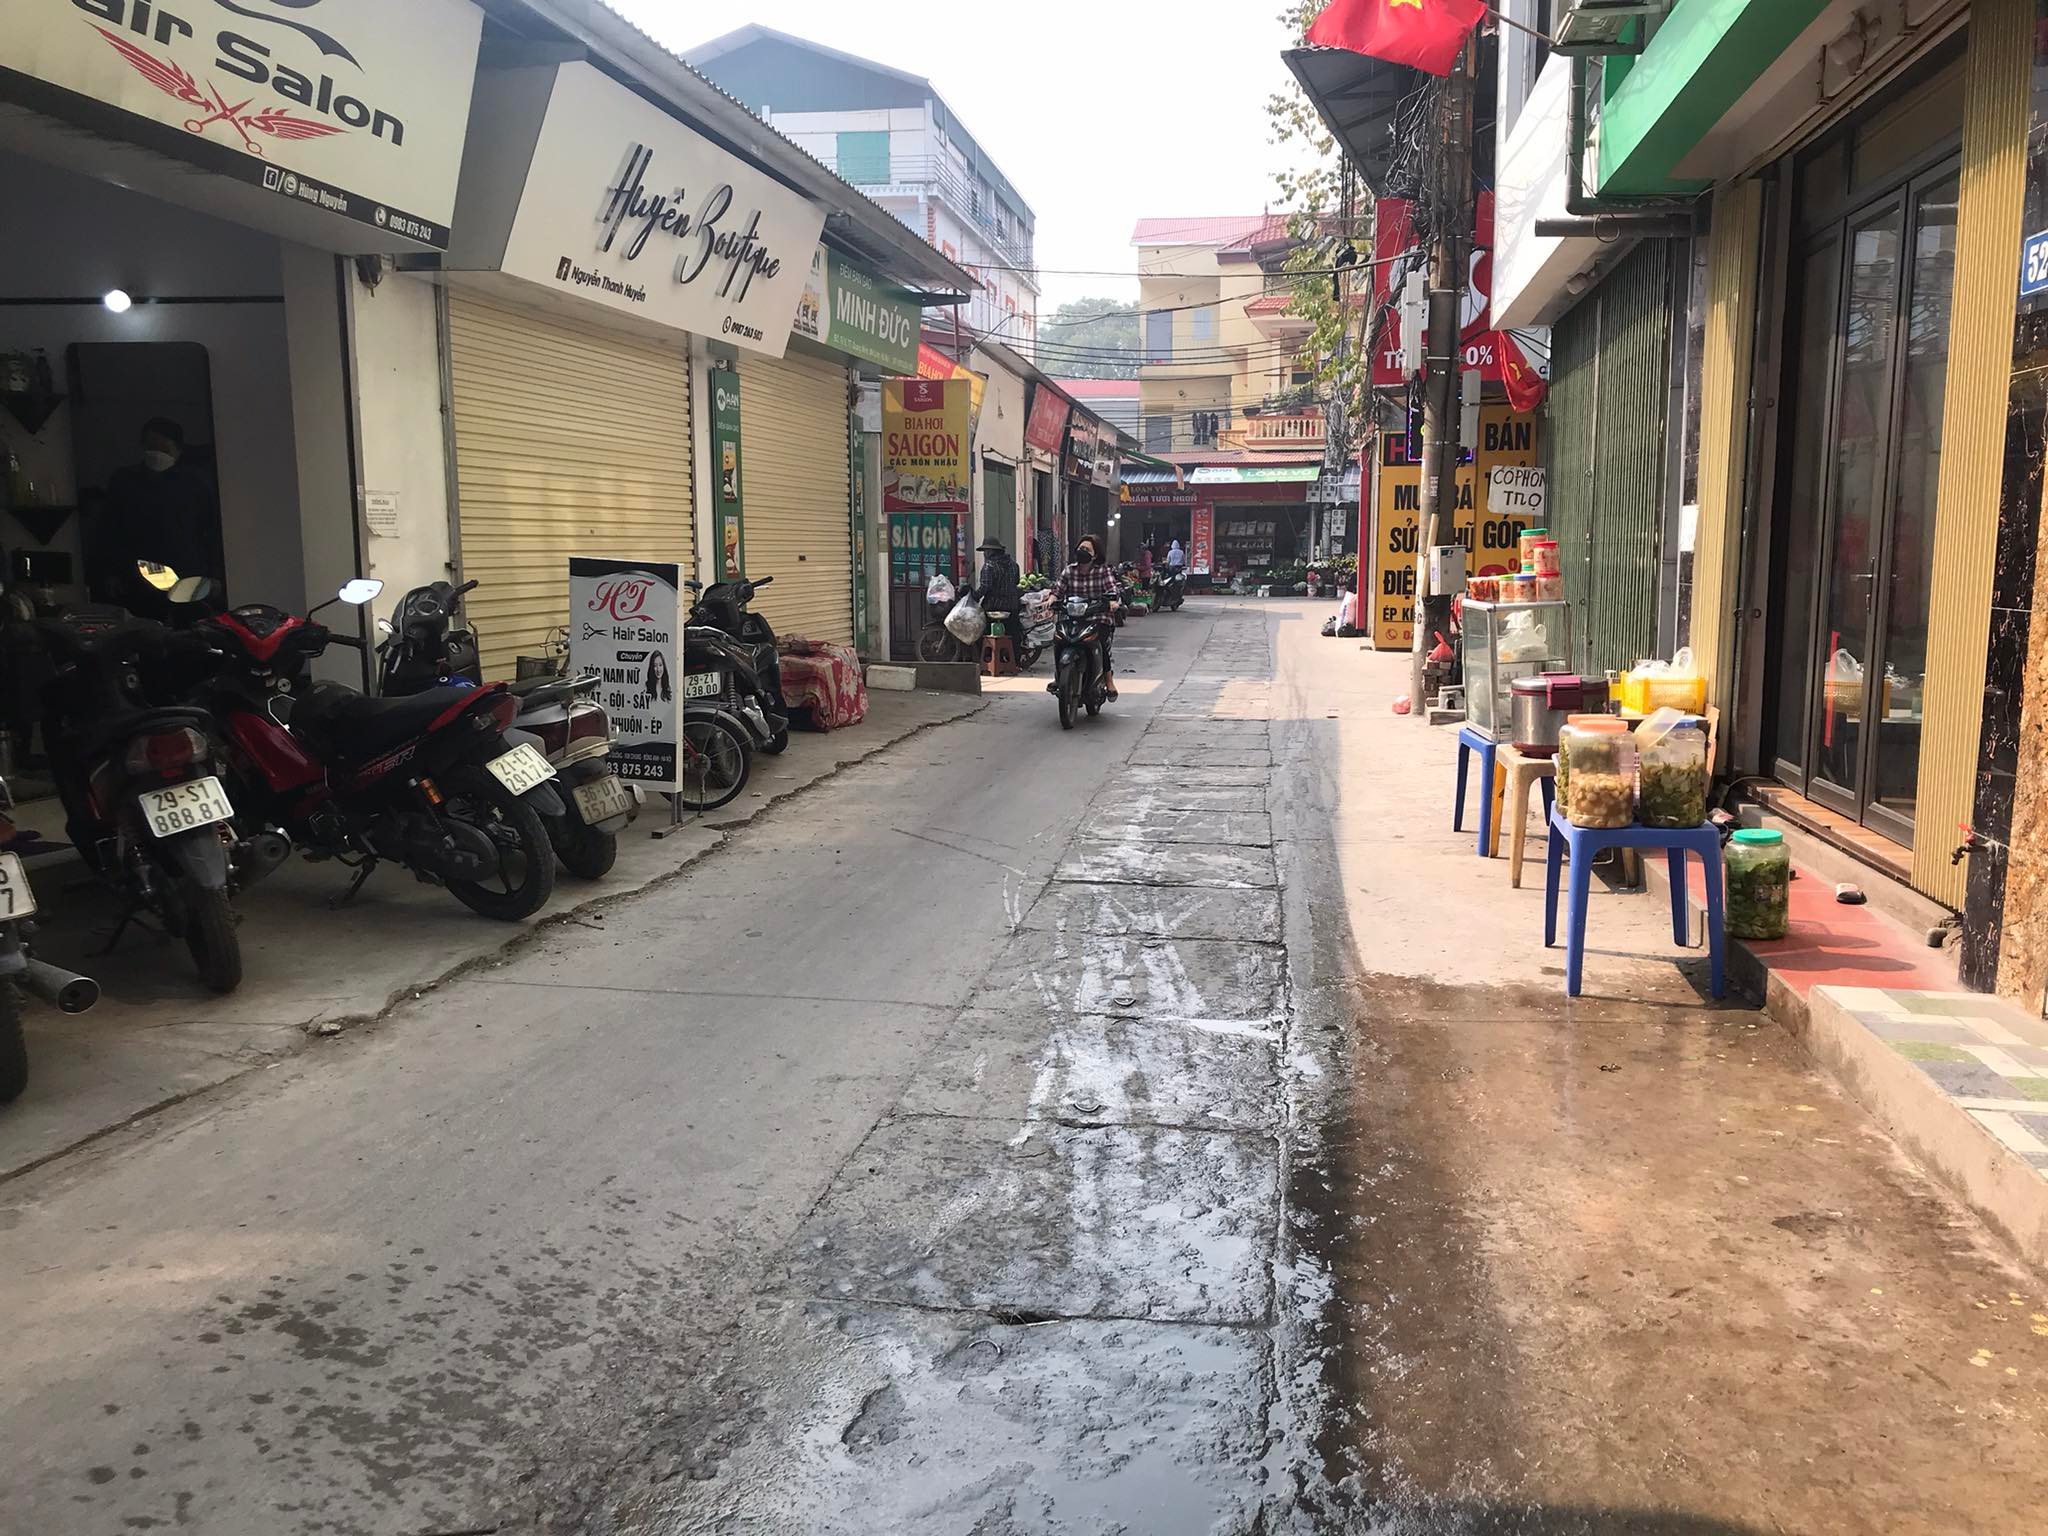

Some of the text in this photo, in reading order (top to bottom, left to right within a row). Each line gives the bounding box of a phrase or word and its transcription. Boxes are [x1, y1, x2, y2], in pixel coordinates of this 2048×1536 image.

[214, 29, 405, 147] Salon
[406, 221, 420, 236] 875
[419, 225, 432, 240] 243
[836, 287, 910, 348] MINH ĐỨC
[888, 432, 960, 457] SAIGON
[1484, 416, 1531, 451] BÁN
[1483, 513, 1527, 549] GÓP
[1383, 565, 1418, 600] ĐIỆ
[1382, 604, 1398, 621] ÉP
[612, 626, 669, 644] Hair Salon
[603, 667, 625, 685] NAM
[688, 673, 714, 687] 29-Z1
[609, 690, 625, 711] GỘI
[650, 717, 663, 735] ÉP
[621, 762, 642, 776] 875
[643, 764, 664, 778] 243
[152, 782, 210, 812] 29-S1
[154, 799, 226, 833] 888.81
